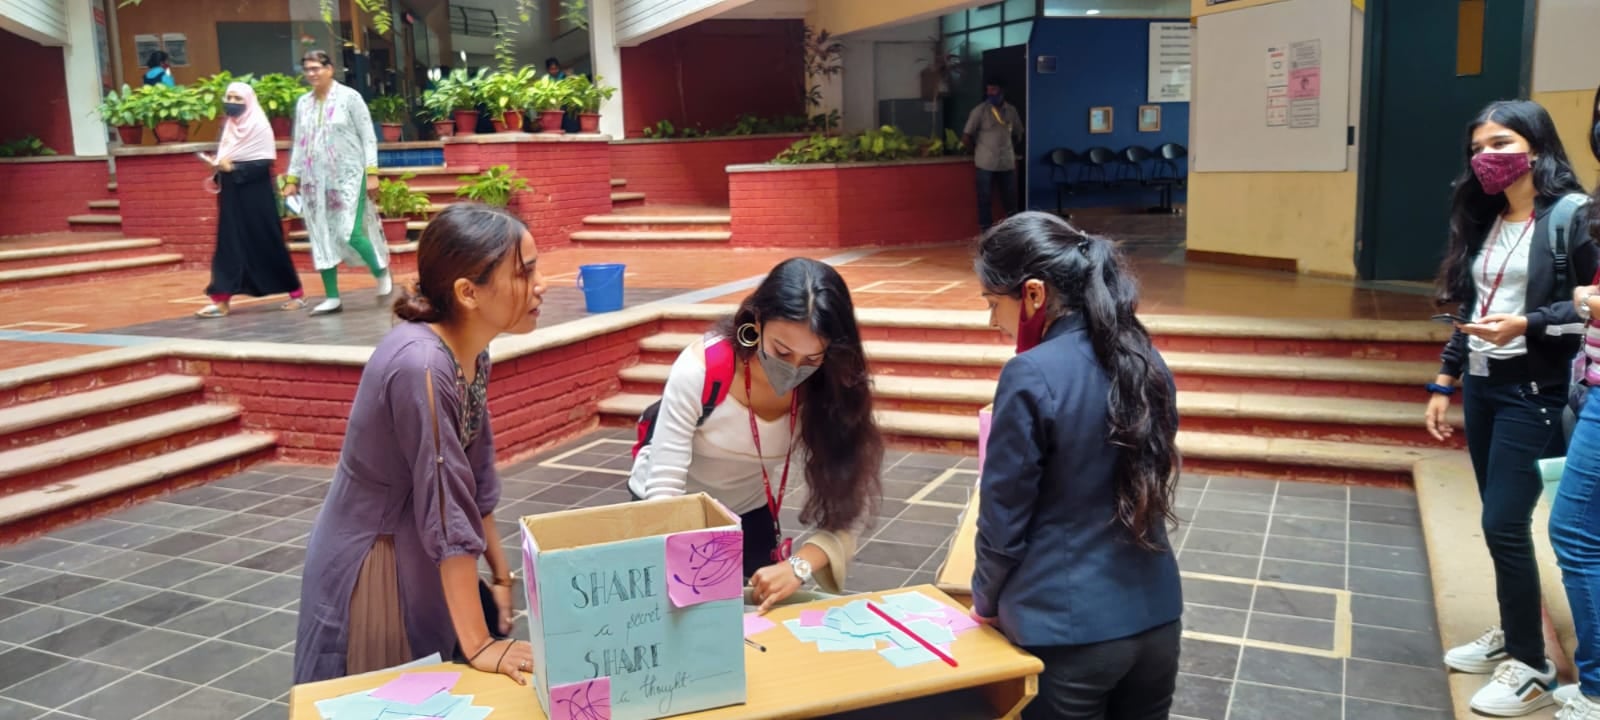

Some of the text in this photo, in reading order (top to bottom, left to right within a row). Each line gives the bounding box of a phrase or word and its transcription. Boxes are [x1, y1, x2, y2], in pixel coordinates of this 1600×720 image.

[571, 565, 657, 609] SHARE
[594, 623, 613, 637] a
[584, 642, 661, 679] SHARE
[617, 672, 688, 714] a thought
